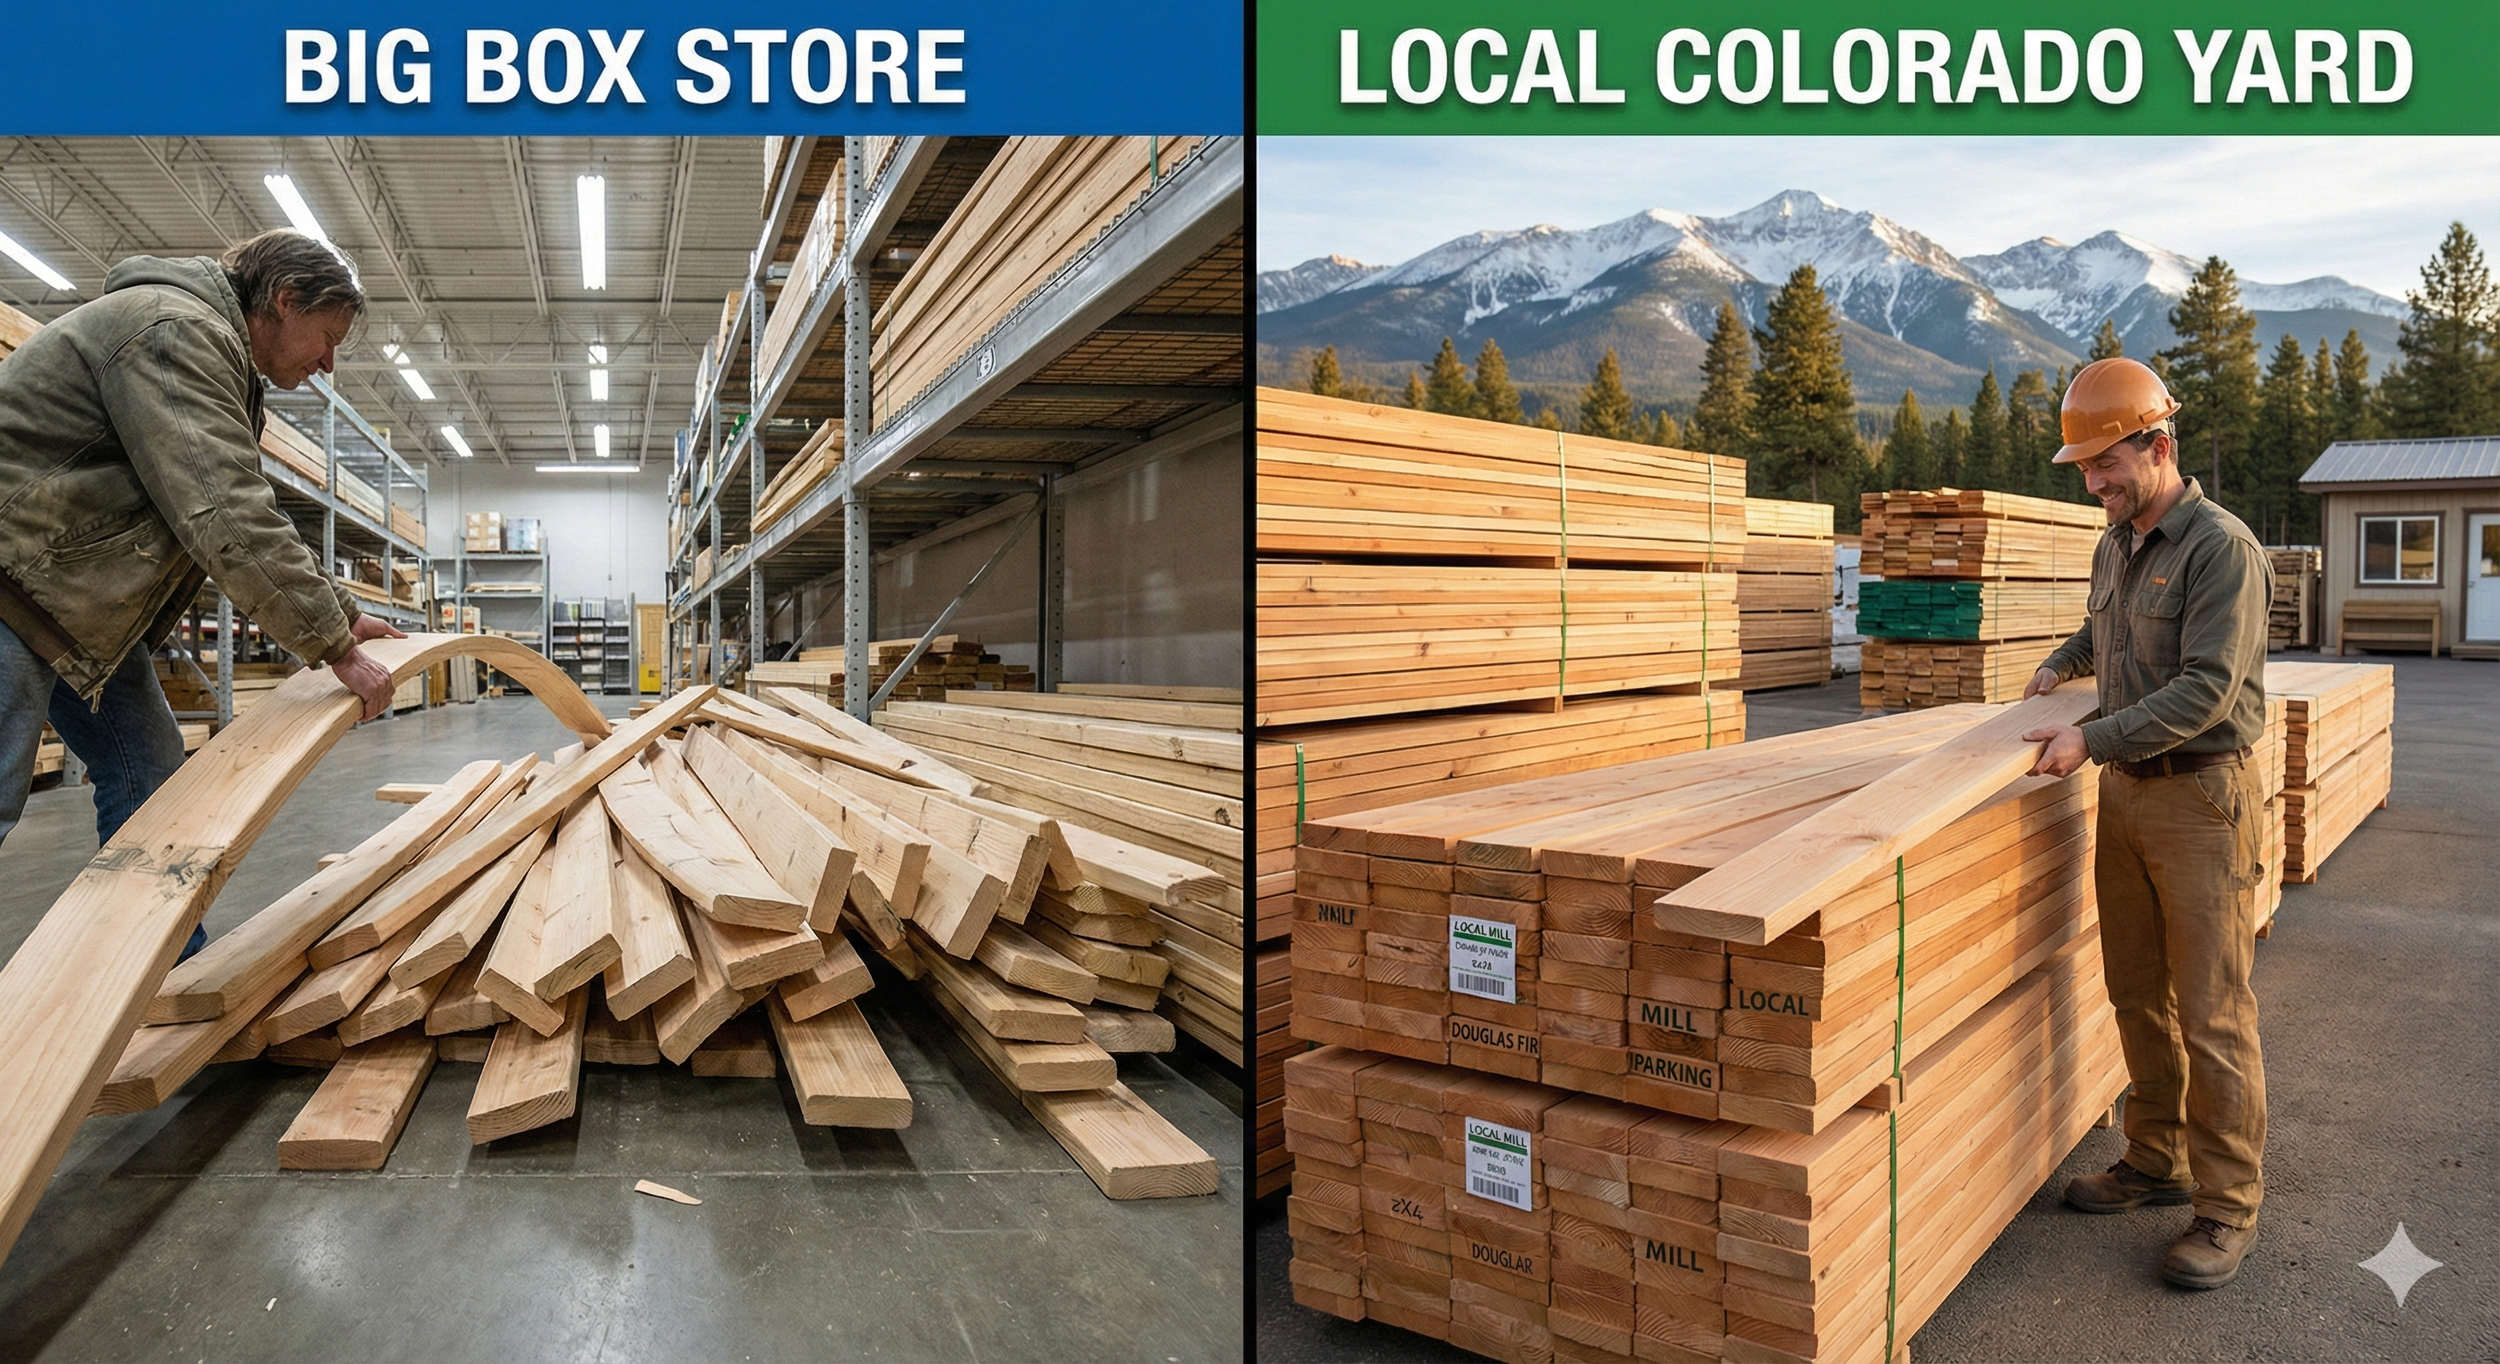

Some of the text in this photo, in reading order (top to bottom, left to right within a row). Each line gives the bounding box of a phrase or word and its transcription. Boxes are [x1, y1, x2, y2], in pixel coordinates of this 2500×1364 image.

[1454, 921, 1487, 936] LOCAL
[1641, 1003, 1697, 1033] MILL
[1739, 989, 1809, 1017] LOCAL
[1452, 1022, 1538, 1054] DOUGLAS FIR
[1469, 1123, 1527, 1148] LOCAL MILL
[1472, 1243, 1533, 1275] DOUGLAR
[1645, 1239, 1704, 1273] MILL
